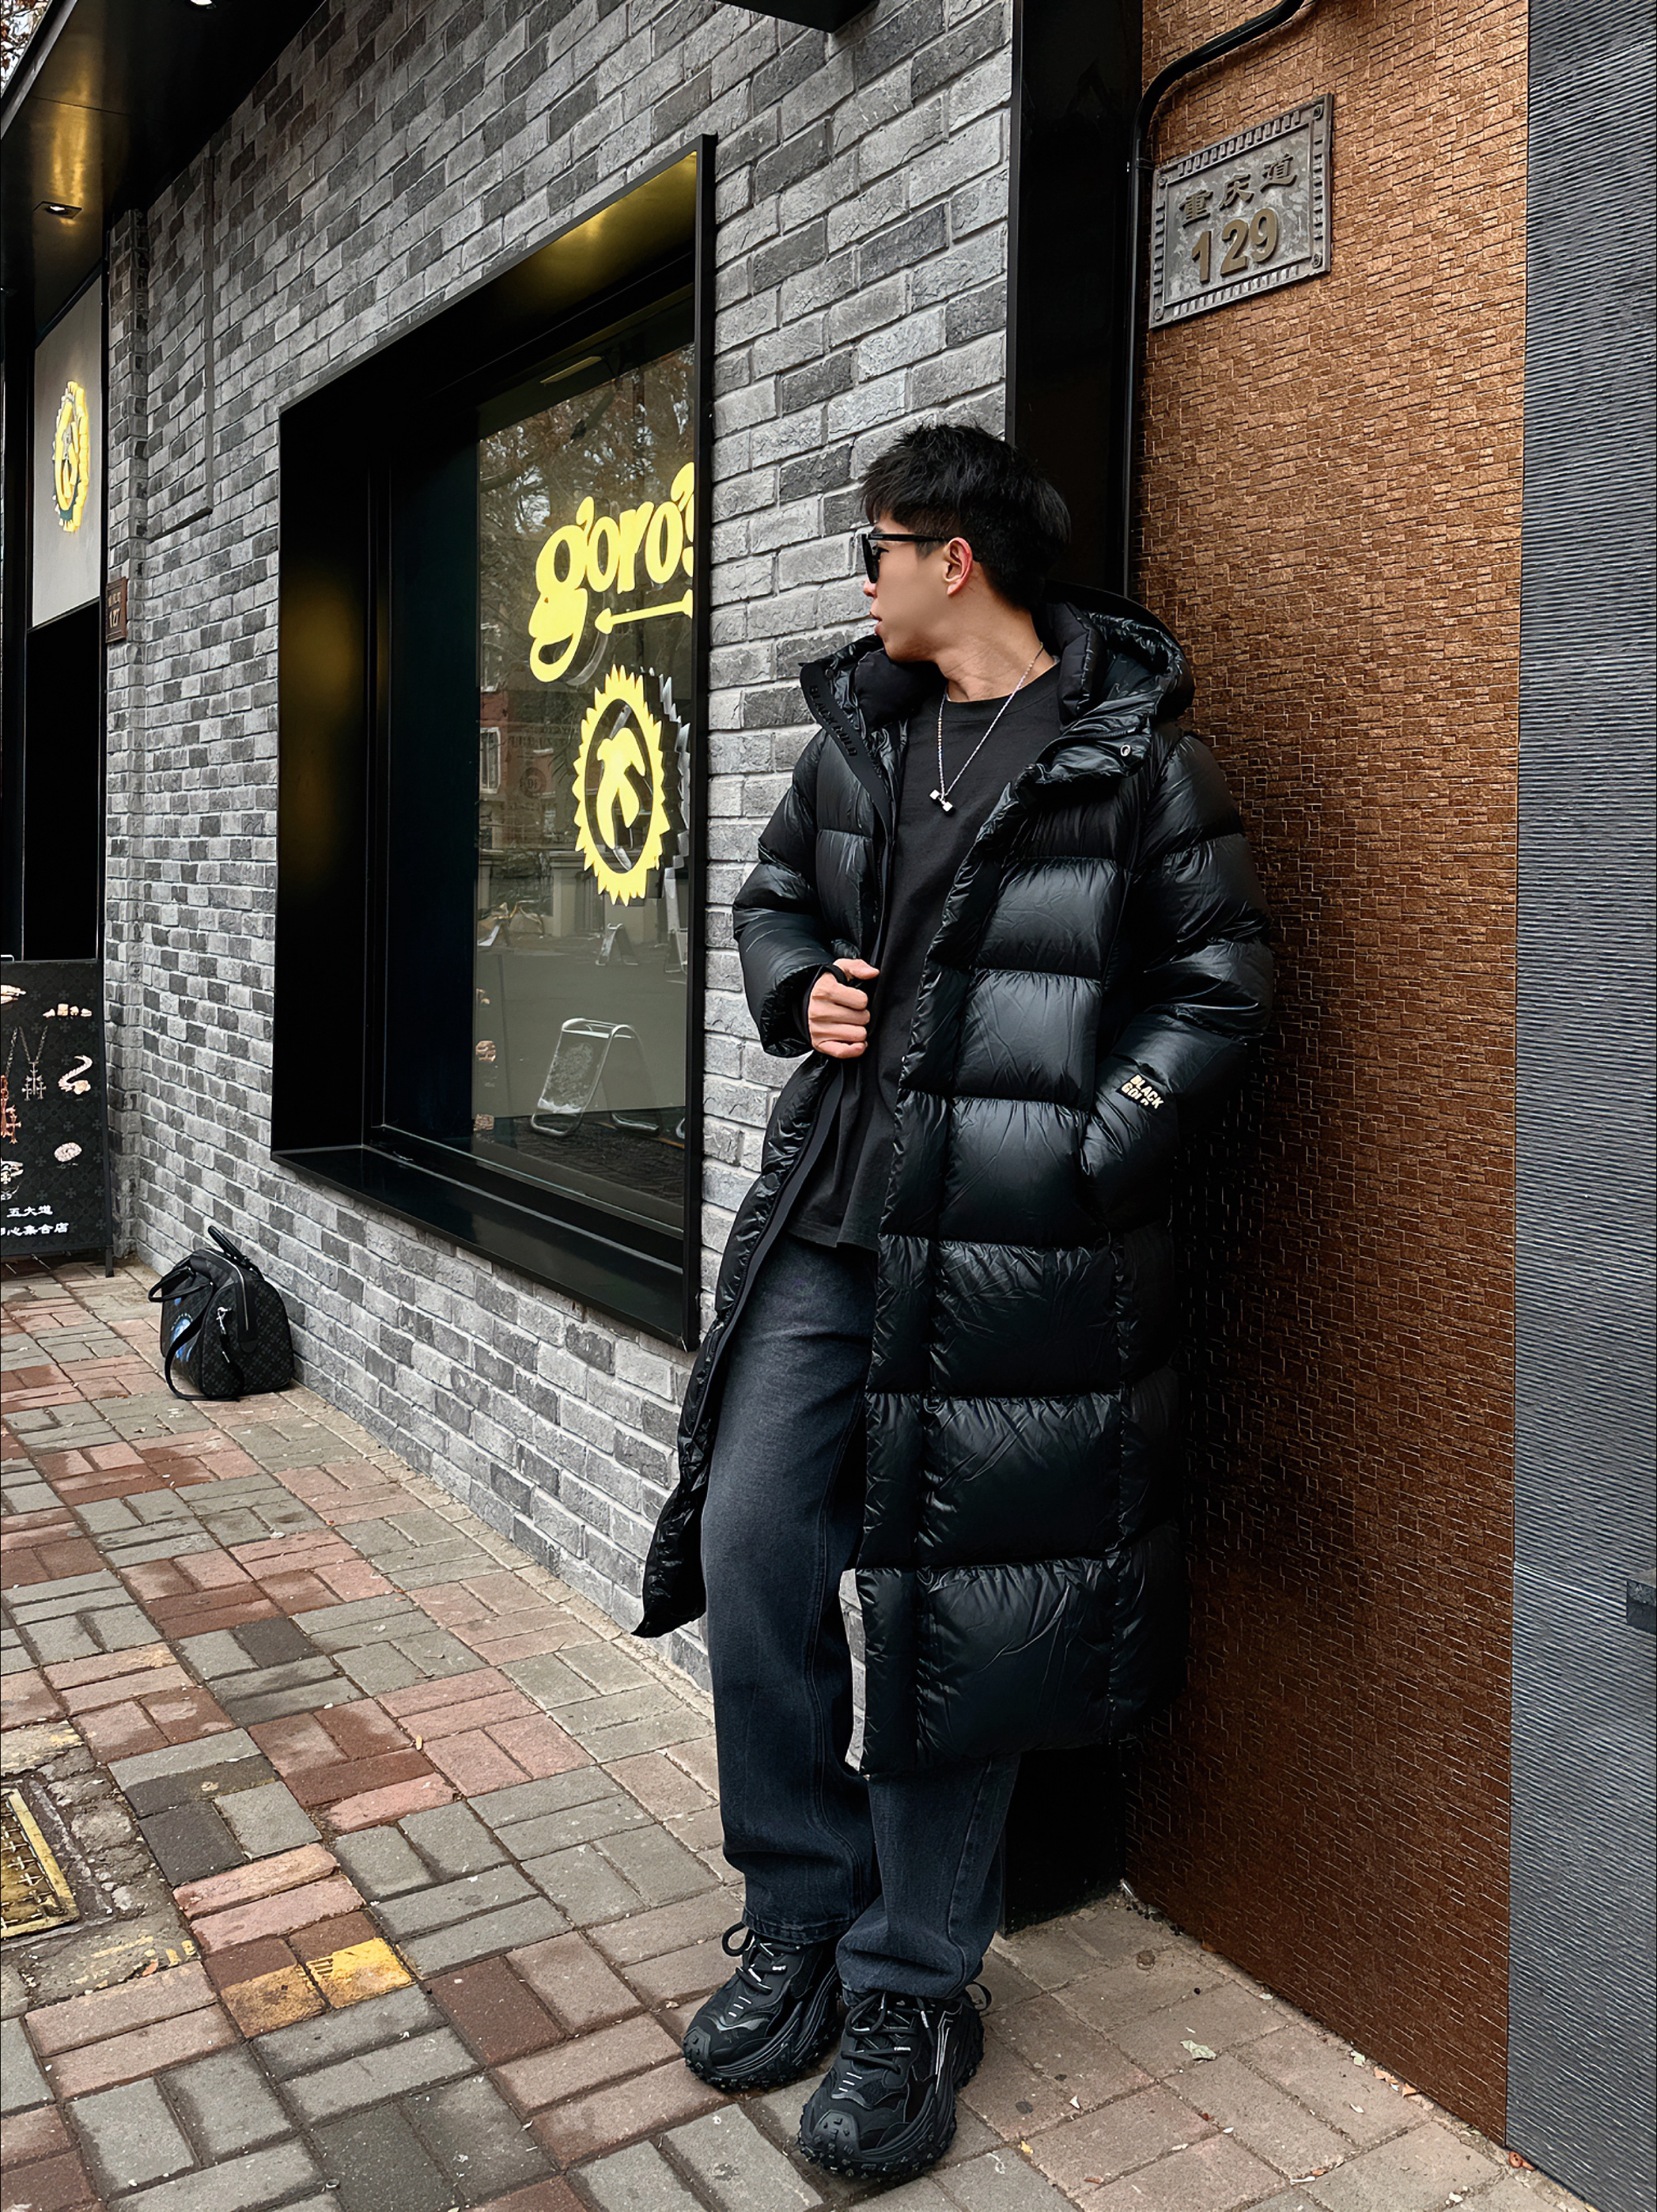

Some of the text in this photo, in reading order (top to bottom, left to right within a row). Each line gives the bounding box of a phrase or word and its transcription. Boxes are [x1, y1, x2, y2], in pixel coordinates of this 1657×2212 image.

[1179, 153, 1298, 229] 重庆道
[1191, 208, 1279, 283] 129
[809, 685, 857, 756] BLACK GOLD
[1130, 1074, 1164, 1109] BLACK
[6, 1205, 53, 1218] 五大道
